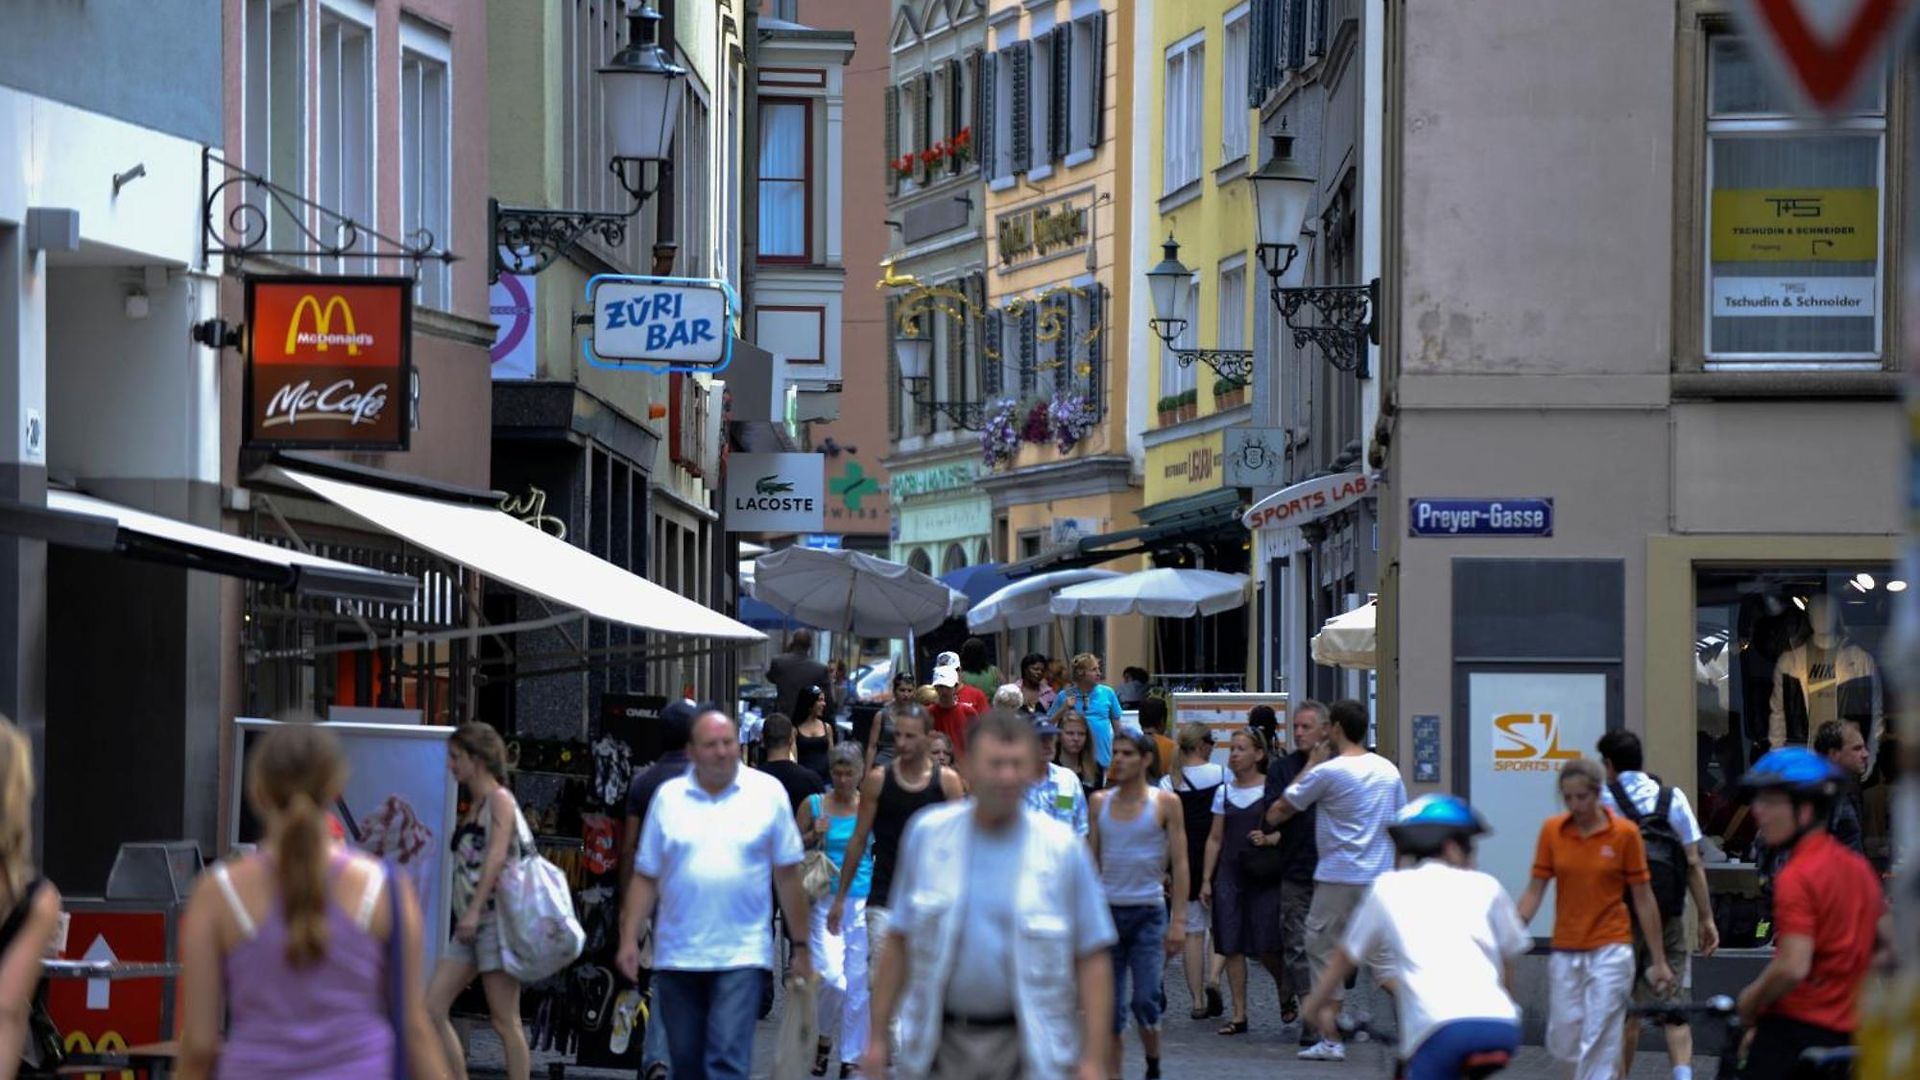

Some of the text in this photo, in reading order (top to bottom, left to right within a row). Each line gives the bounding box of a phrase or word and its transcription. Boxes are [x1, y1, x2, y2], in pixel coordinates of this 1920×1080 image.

[1725, 296, 1861, 307] Tschudin & Schneider
[297, 332, 373, 345] McDonald's
[645, 318, 715, 351] BAR
[736, 497, 814, 511] LACOSTE
[1250, 477, 1368, 529] SPORTS LAB
[1418, 503, 1544, 533] Preyer-Gasse
[1494, 761, 1550, 771] SPORTS
